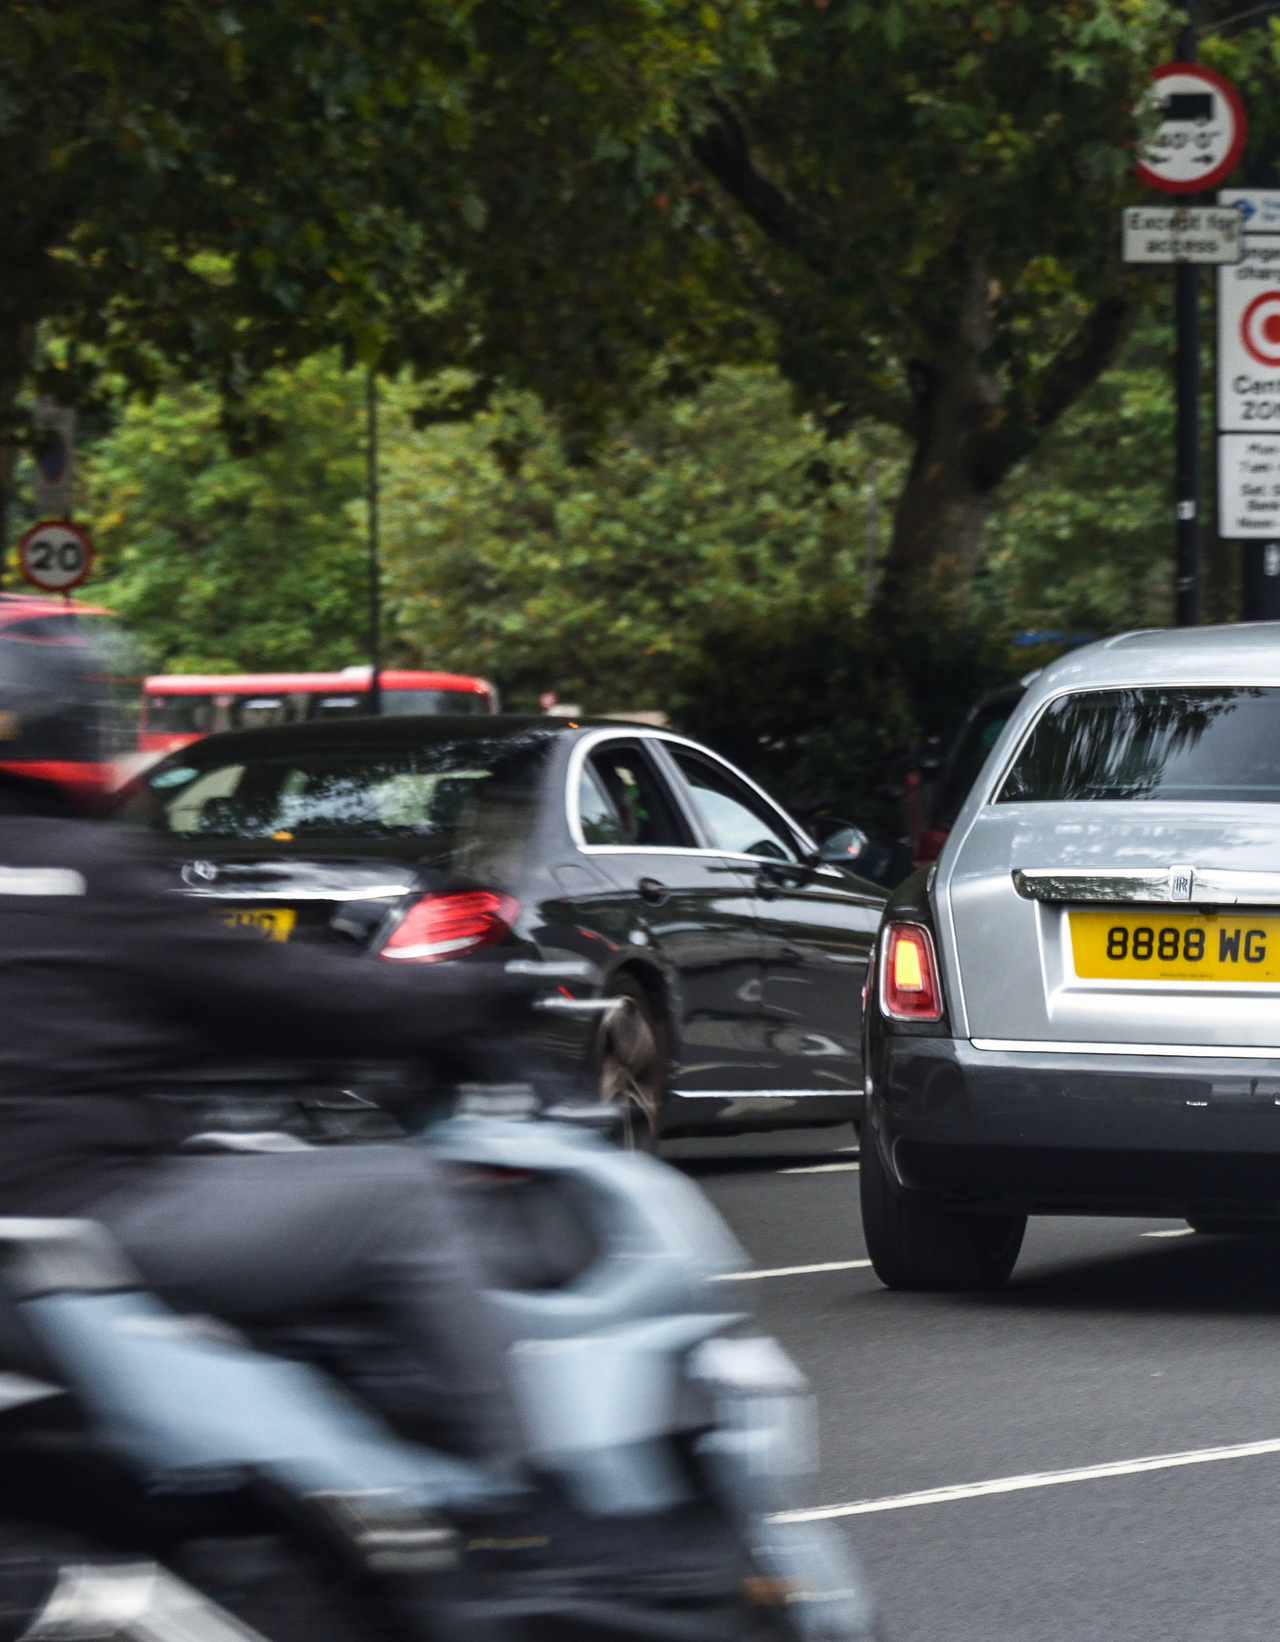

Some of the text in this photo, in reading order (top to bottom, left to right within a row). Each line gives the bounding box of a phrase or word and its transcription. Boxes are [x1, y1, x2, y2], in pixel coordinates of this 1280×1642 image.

[1130, 212, 1237, 232] Except for
[1146, 240, 1219, 254] access
[32, 541, 83, 572] 20
[1106, 926, 1267, 963] 8888 WG
